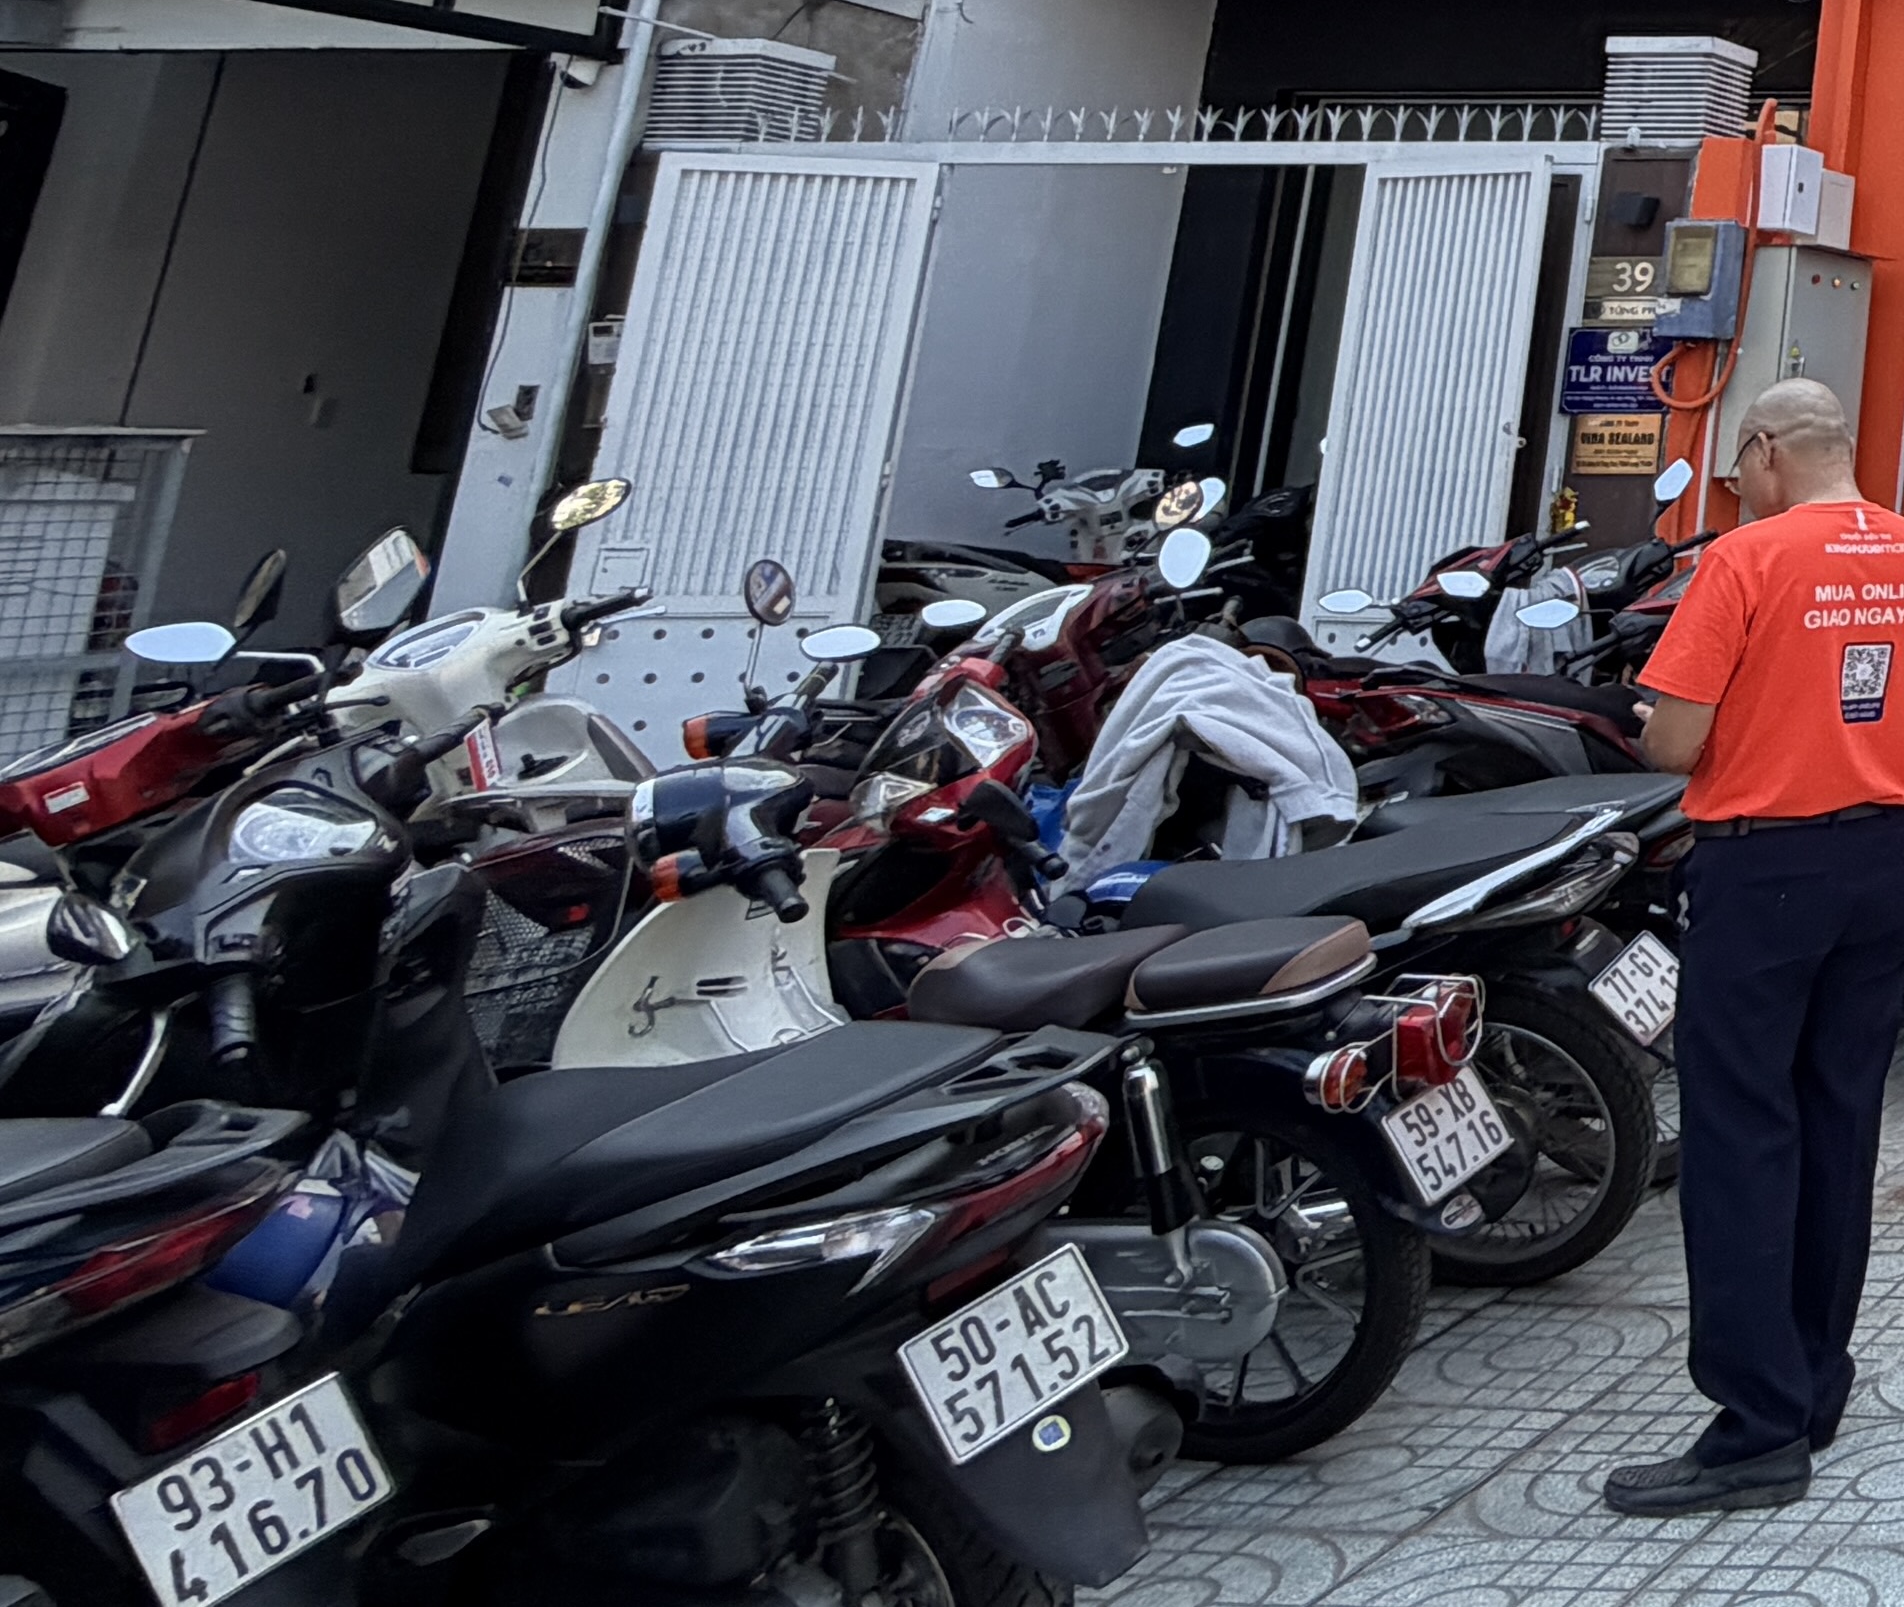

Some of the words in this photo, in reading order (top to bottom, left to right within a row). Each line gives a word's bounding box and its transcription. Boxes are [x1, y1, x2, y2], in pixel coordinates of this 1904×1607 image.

[1612, 261, 1656, 293] 39
[1569, 365, 1603, 383] TLR
[1606, 365, 1672, 383] INVET
[1803, 609, 1851, 630] GIAO
[1814, 584, 1856, 603] MUA
[1416, 1109, 1501, 1191] 547.16
[930, 1270, 1071, 1382] 50-AC
[943, 1314, 1112, 1444] 571.52
[156, 1402, 327, 1532] 93-H1
[169, 1448, 378, 1603] 416.70
